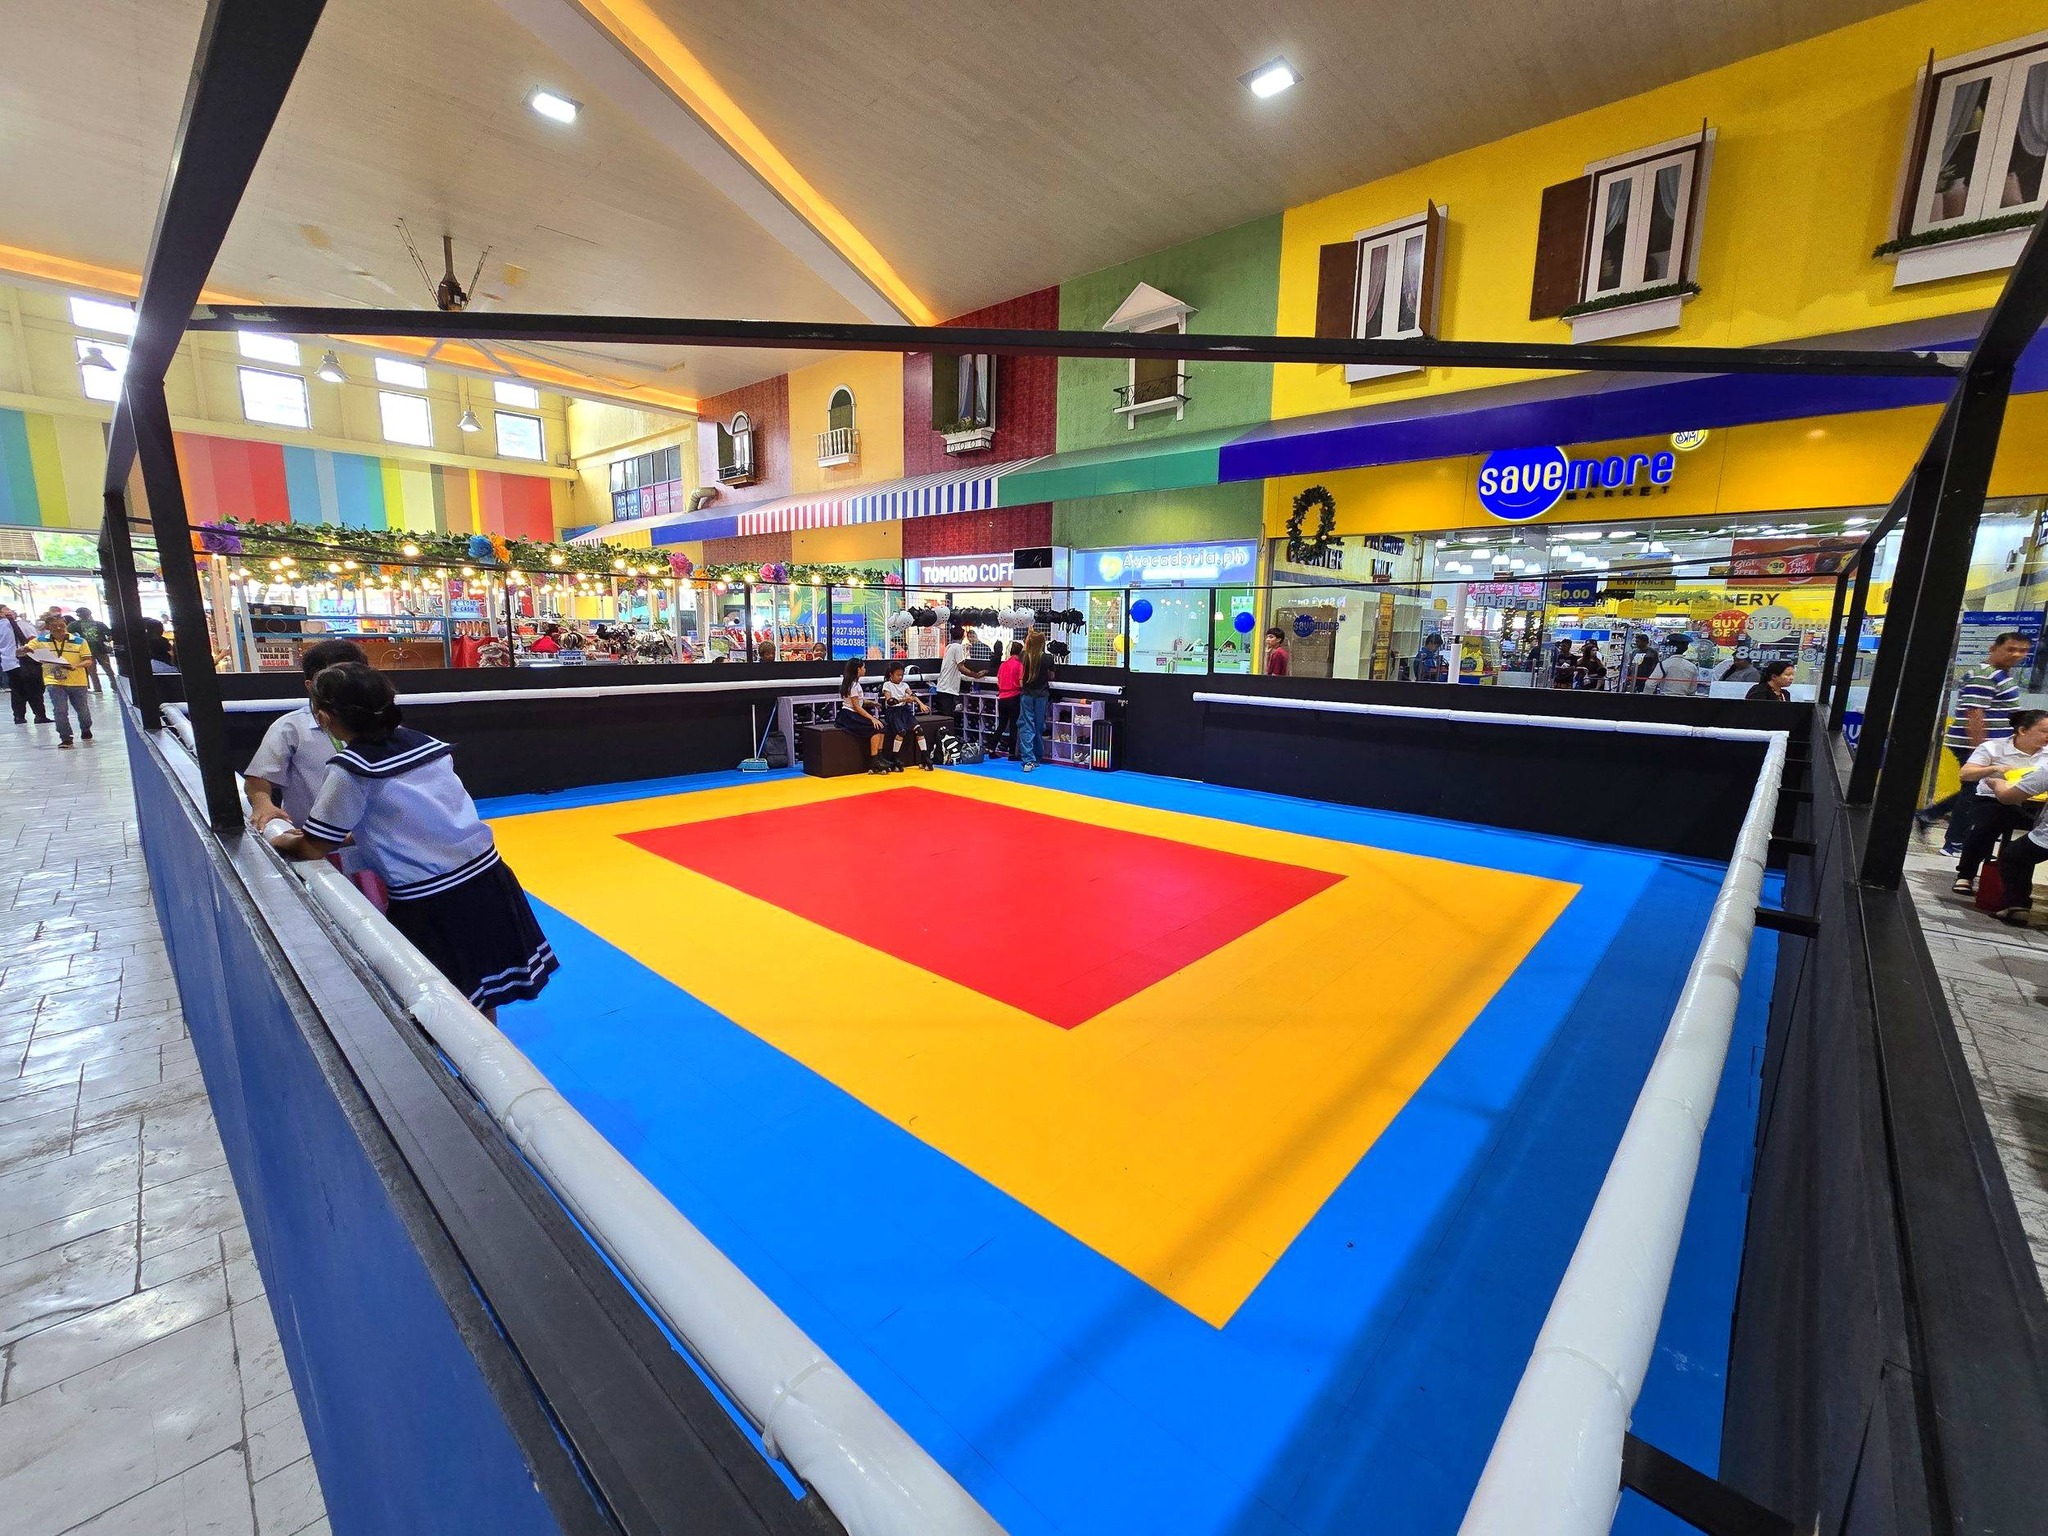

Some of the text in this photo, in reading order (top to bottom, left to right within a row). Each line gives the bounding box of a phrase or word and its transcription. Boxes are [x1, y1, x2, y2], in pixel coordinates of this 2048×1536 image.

[1566, 485, 1670, 501] MARKET
[1122, 549, 1246, 568] Avocadoria.ph
[922, 565, 977, 584] TOMORO
[1712, 619, 1740, 629] BUY
[1659, 645, 1677, 653] Exit
[1736, 646, 1781, 660] 8am
